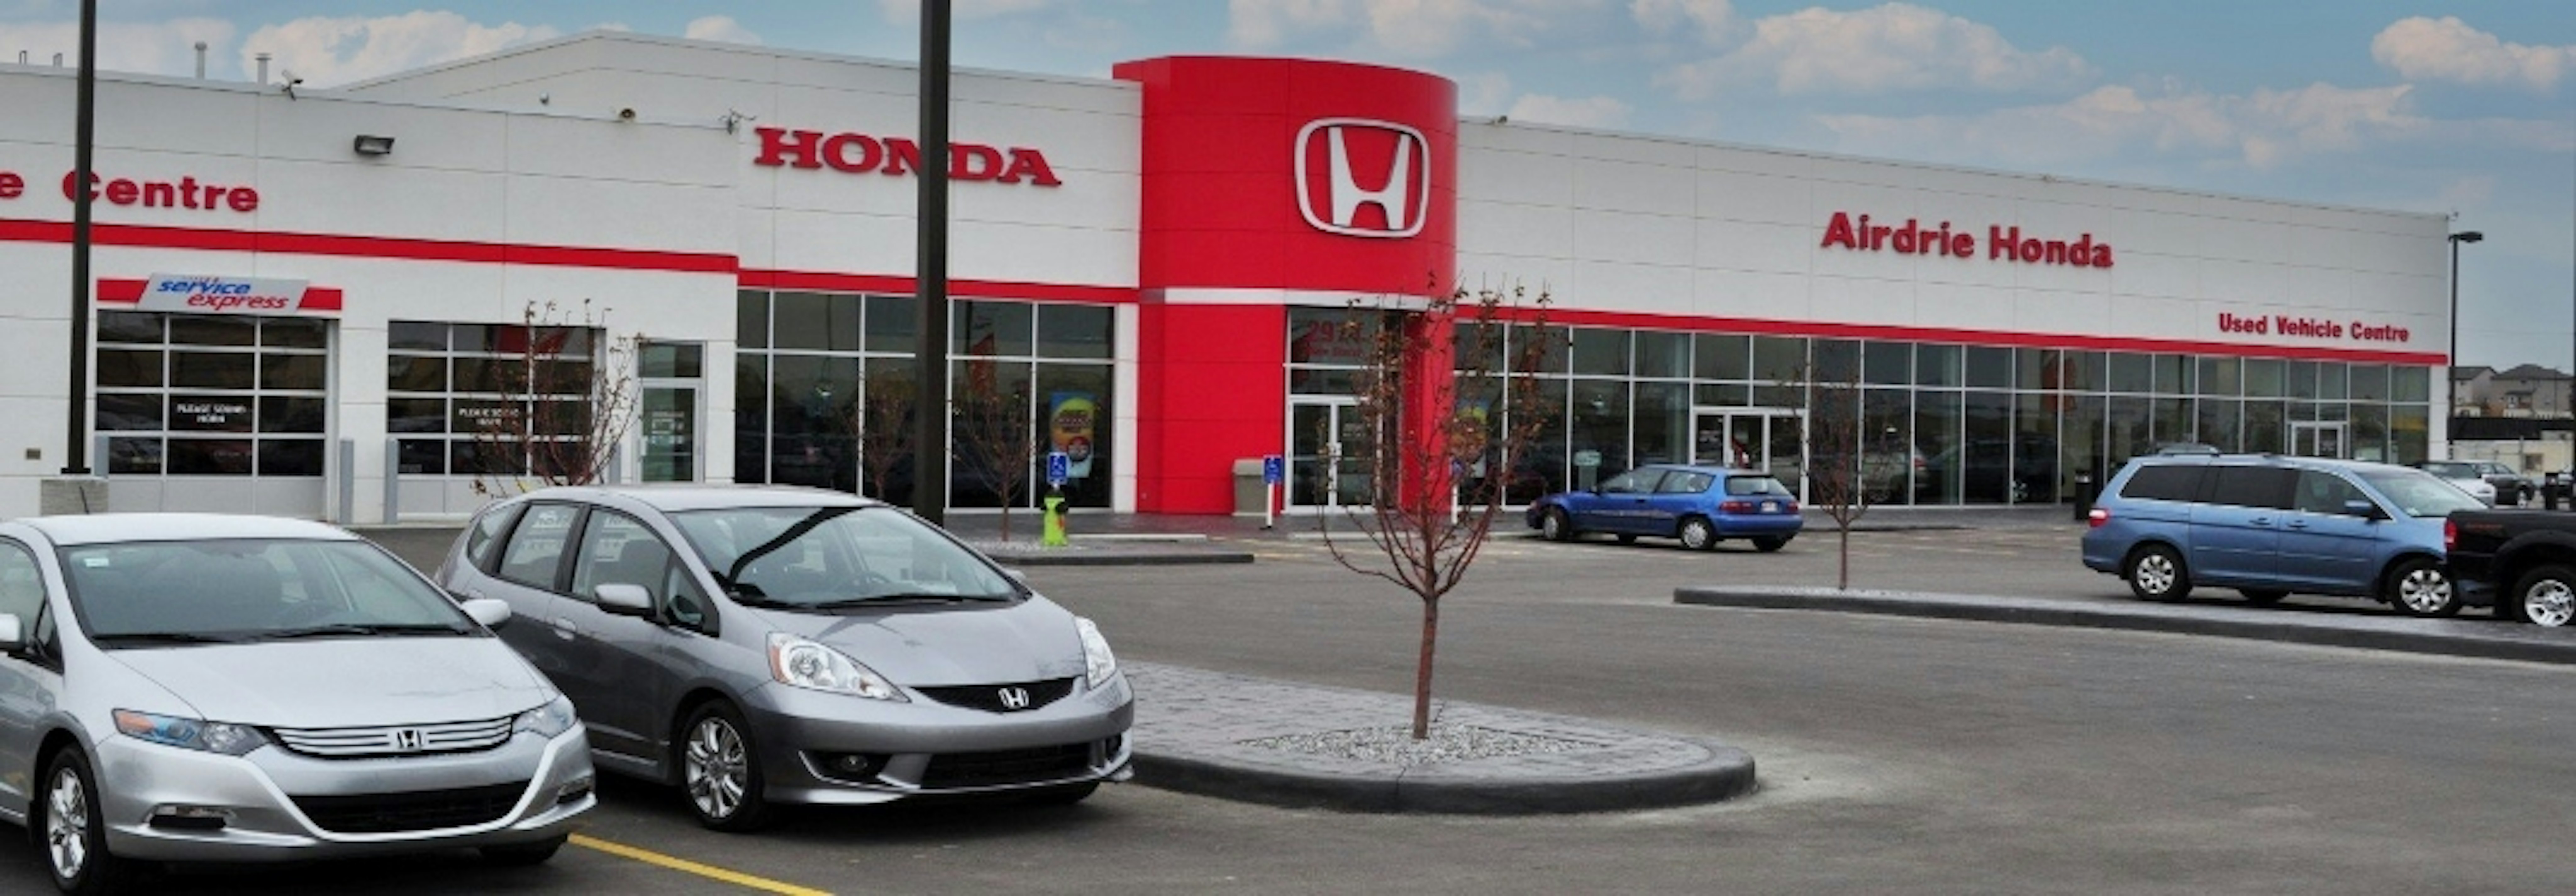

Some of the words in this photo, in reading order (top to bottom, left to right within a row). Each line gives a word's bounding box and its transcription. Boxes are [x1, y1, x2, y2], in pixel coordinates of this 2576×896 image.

[755, 126, 1062, 187] HONDA
[61, 171, 259, 212] Centre
[1821, 211, 1974, 258] Airdrie
[1988, 225, 2114, 268] Honda
[158, 280, 251, 294] service
[188, 293, 289, 311] express
[2219, 313, 2268, 334] Used
[2276, 316, 2343, 338] Vehicle
[2351, 322, 2409, 342] Centre
